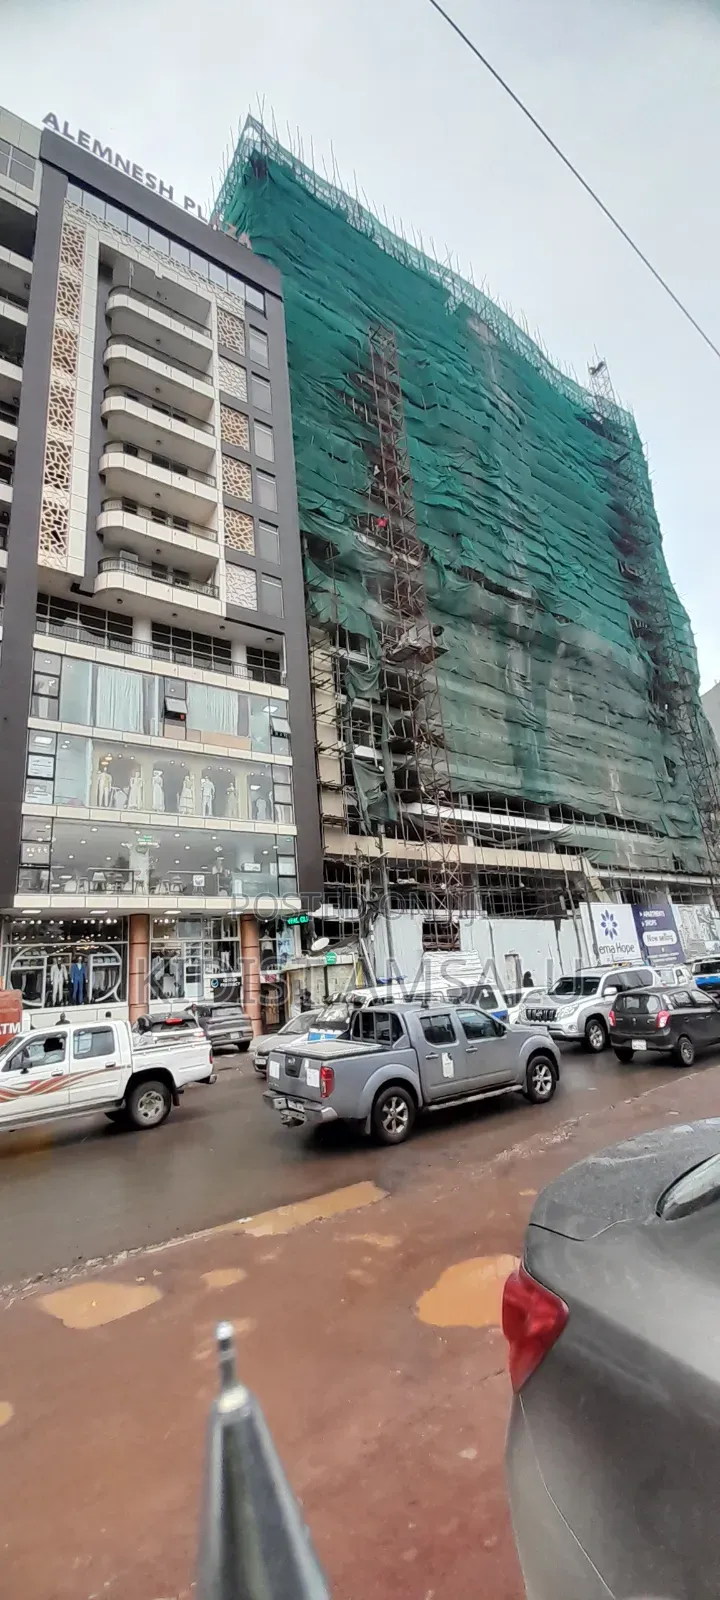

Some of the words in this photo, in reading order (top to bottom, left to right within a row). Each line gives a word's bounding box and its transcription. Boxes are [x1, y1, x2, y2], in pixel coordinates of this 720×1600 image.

[42, 111, 175, 200] ALEMNESH
[598, 944, 616, 955] ema
[616, 942, 636, 956] Hope
